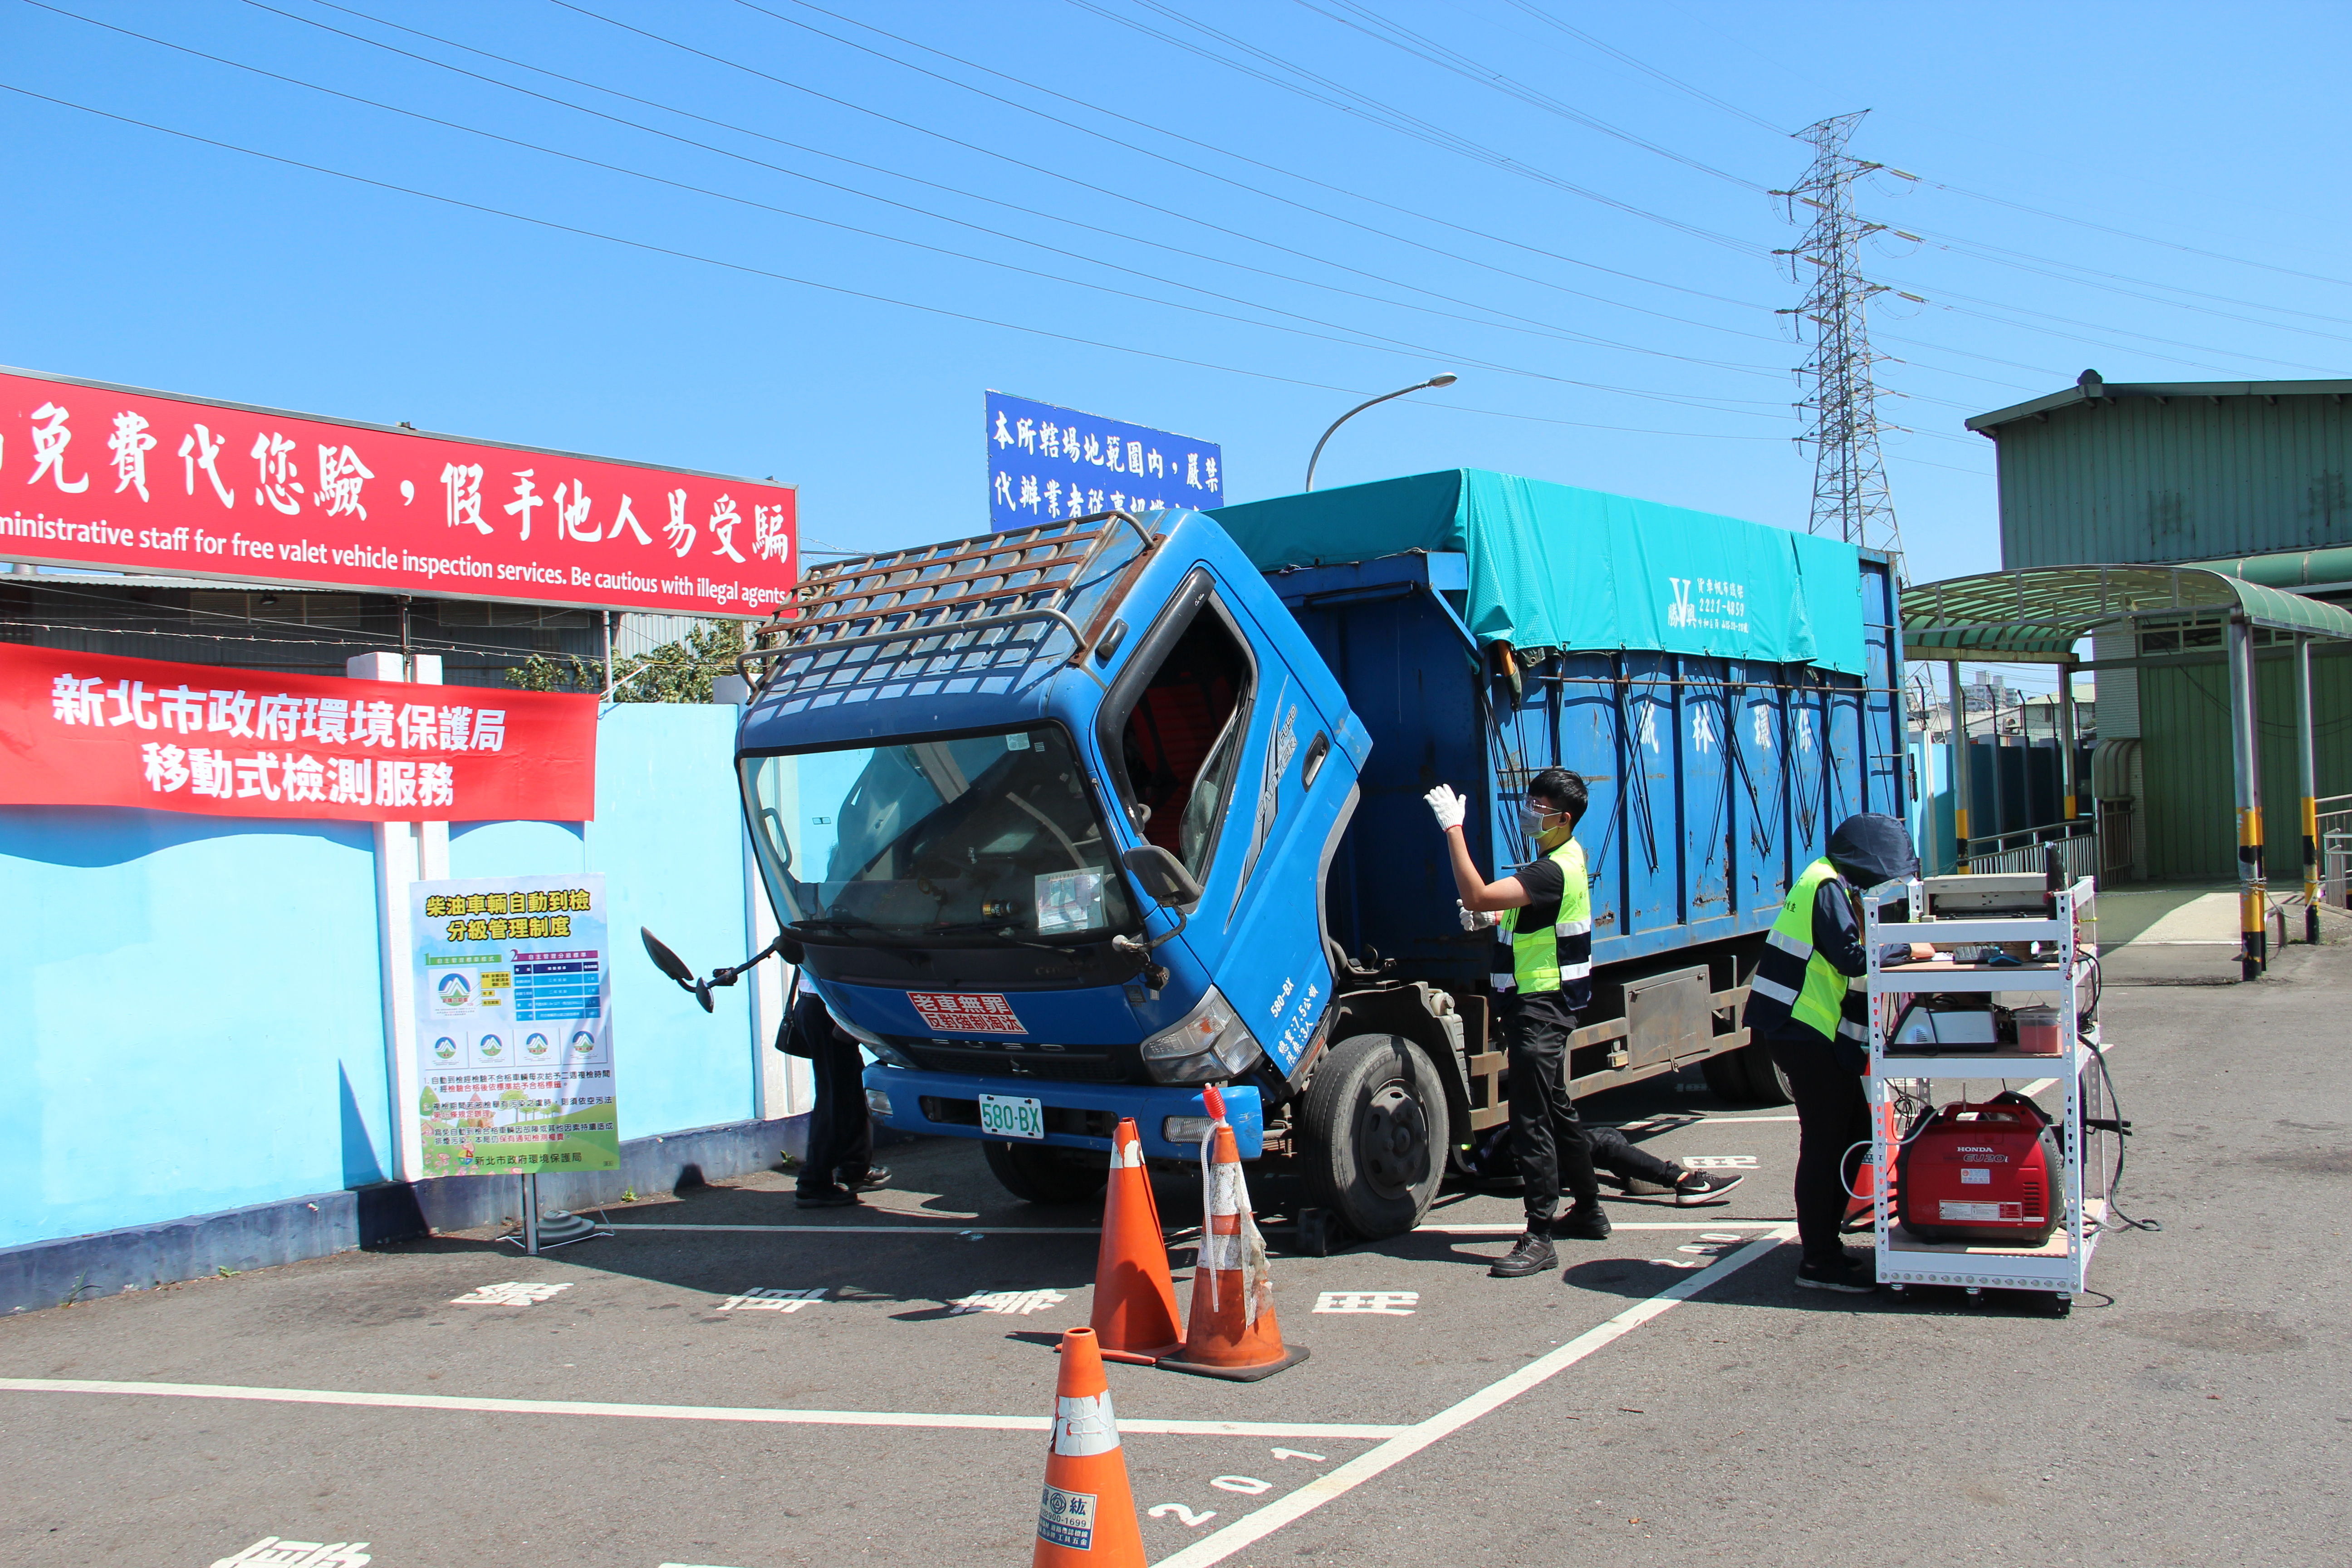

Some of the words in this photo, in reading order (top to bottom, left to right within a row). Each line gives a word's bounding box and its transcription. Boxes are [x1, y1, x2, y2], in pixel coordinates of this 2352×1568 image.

[993, 410, 1219, 493] 本所轄場地範圍內，嚴禁
[0, 401, 789, 564] 免費代您驗，假手他人易受騙
[140, 527, 189, 551] staff
[194, 529, 227, 554] for
[232, 533, 274, 559] free
[279, 539, 327, 564] valet
[332, 544, 397, 570] vehicle
[403, 549, 492, 579] inspection
[497, 562, 567, 584] services.
[572, 567, 591, 587] Be
[595, 571, 657, 593] cautious
[661, 576, 693, 595] with
[697, 578, 738, 605] illegal
[52, 672, 506, 752] 新北市政府環境保護局
[1279, 704, 1298, 747] FUSO
[142, 742, 454, 807] 移動式檢測服務
[1256, 735, 1298, 823] CANTER
[426, 888, 591, 918] 柴油車輛自動到檢
[446, 915, 571, 942] 分級管理制度
[913, 994, 1010, 1014] 老車無罪
[1270, 977, 1294, 1018] 580-BX
[925, 1014, 1024, 1031] 反對強制淘汰
[931, 1039, 1065, 1052] FUSO
[982, 1103, 1040, 1133] 580-BX
[475, 1152, 582, 1165] 新北市政府環境保護局
